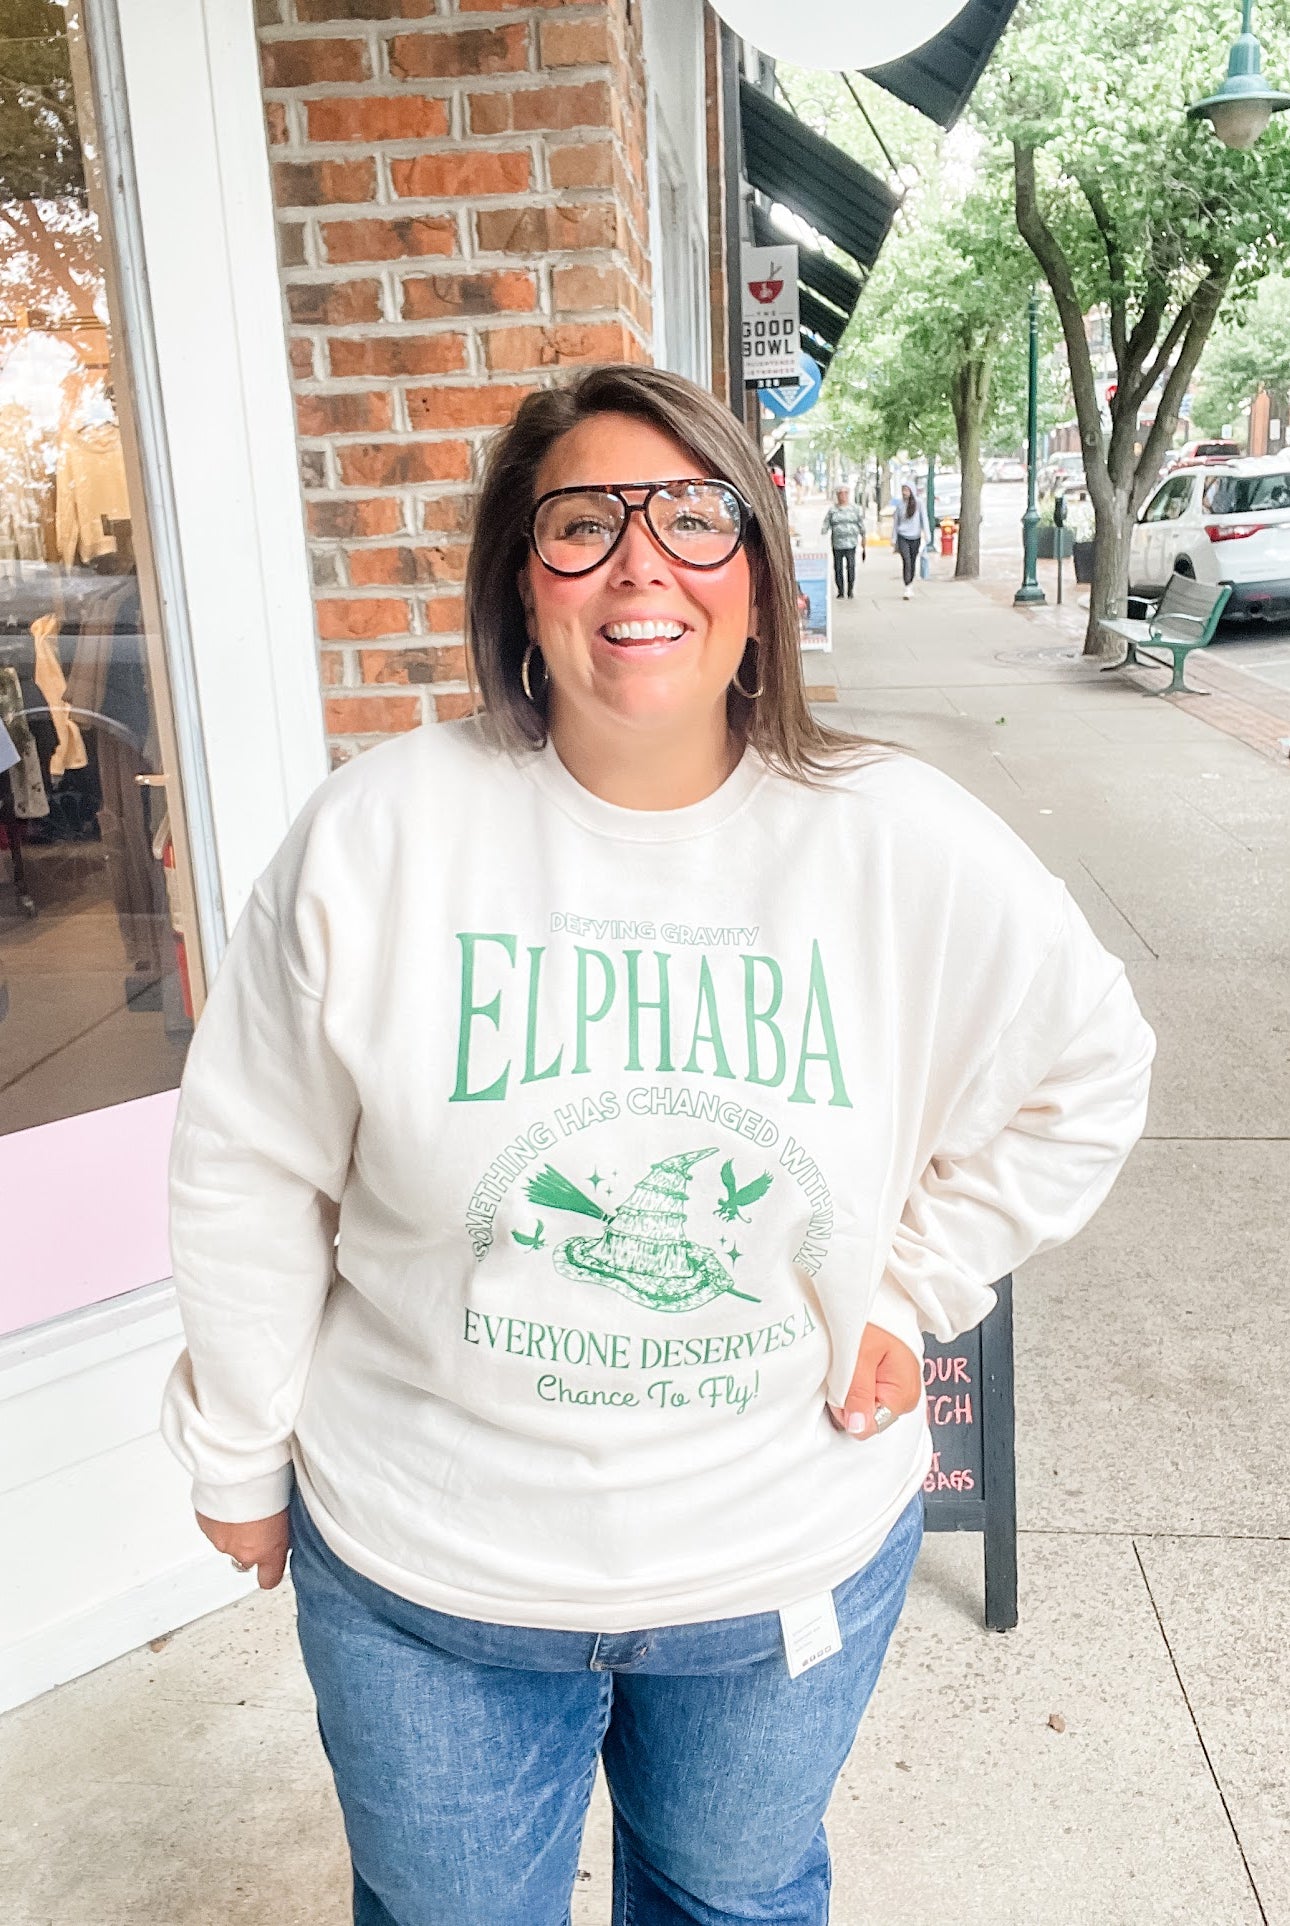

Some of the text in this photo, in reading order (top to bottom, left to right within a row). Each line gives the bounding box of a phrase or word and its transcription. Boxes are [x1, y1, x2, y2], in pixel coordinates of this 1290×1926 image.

[742, 319, 794, 338] GOOD
[742, 339, 794, 357] BOWL
[550, 912, 760, 947] DEFYING GRAVITY
[448, 931, 854, 1109] ELPHABA
[465, 1121, 558, 1263] SOMETHING
[554, 1091, 621, 1138] HAS
[626, 1087, 780, 1150] CHANGED
[778, 1136, 835, 1240] WITHIN
[463, 1302, 817, 1370] EVERYONE DESERVES A
[536, 1369, 761, 1415] Chance To Fly!
